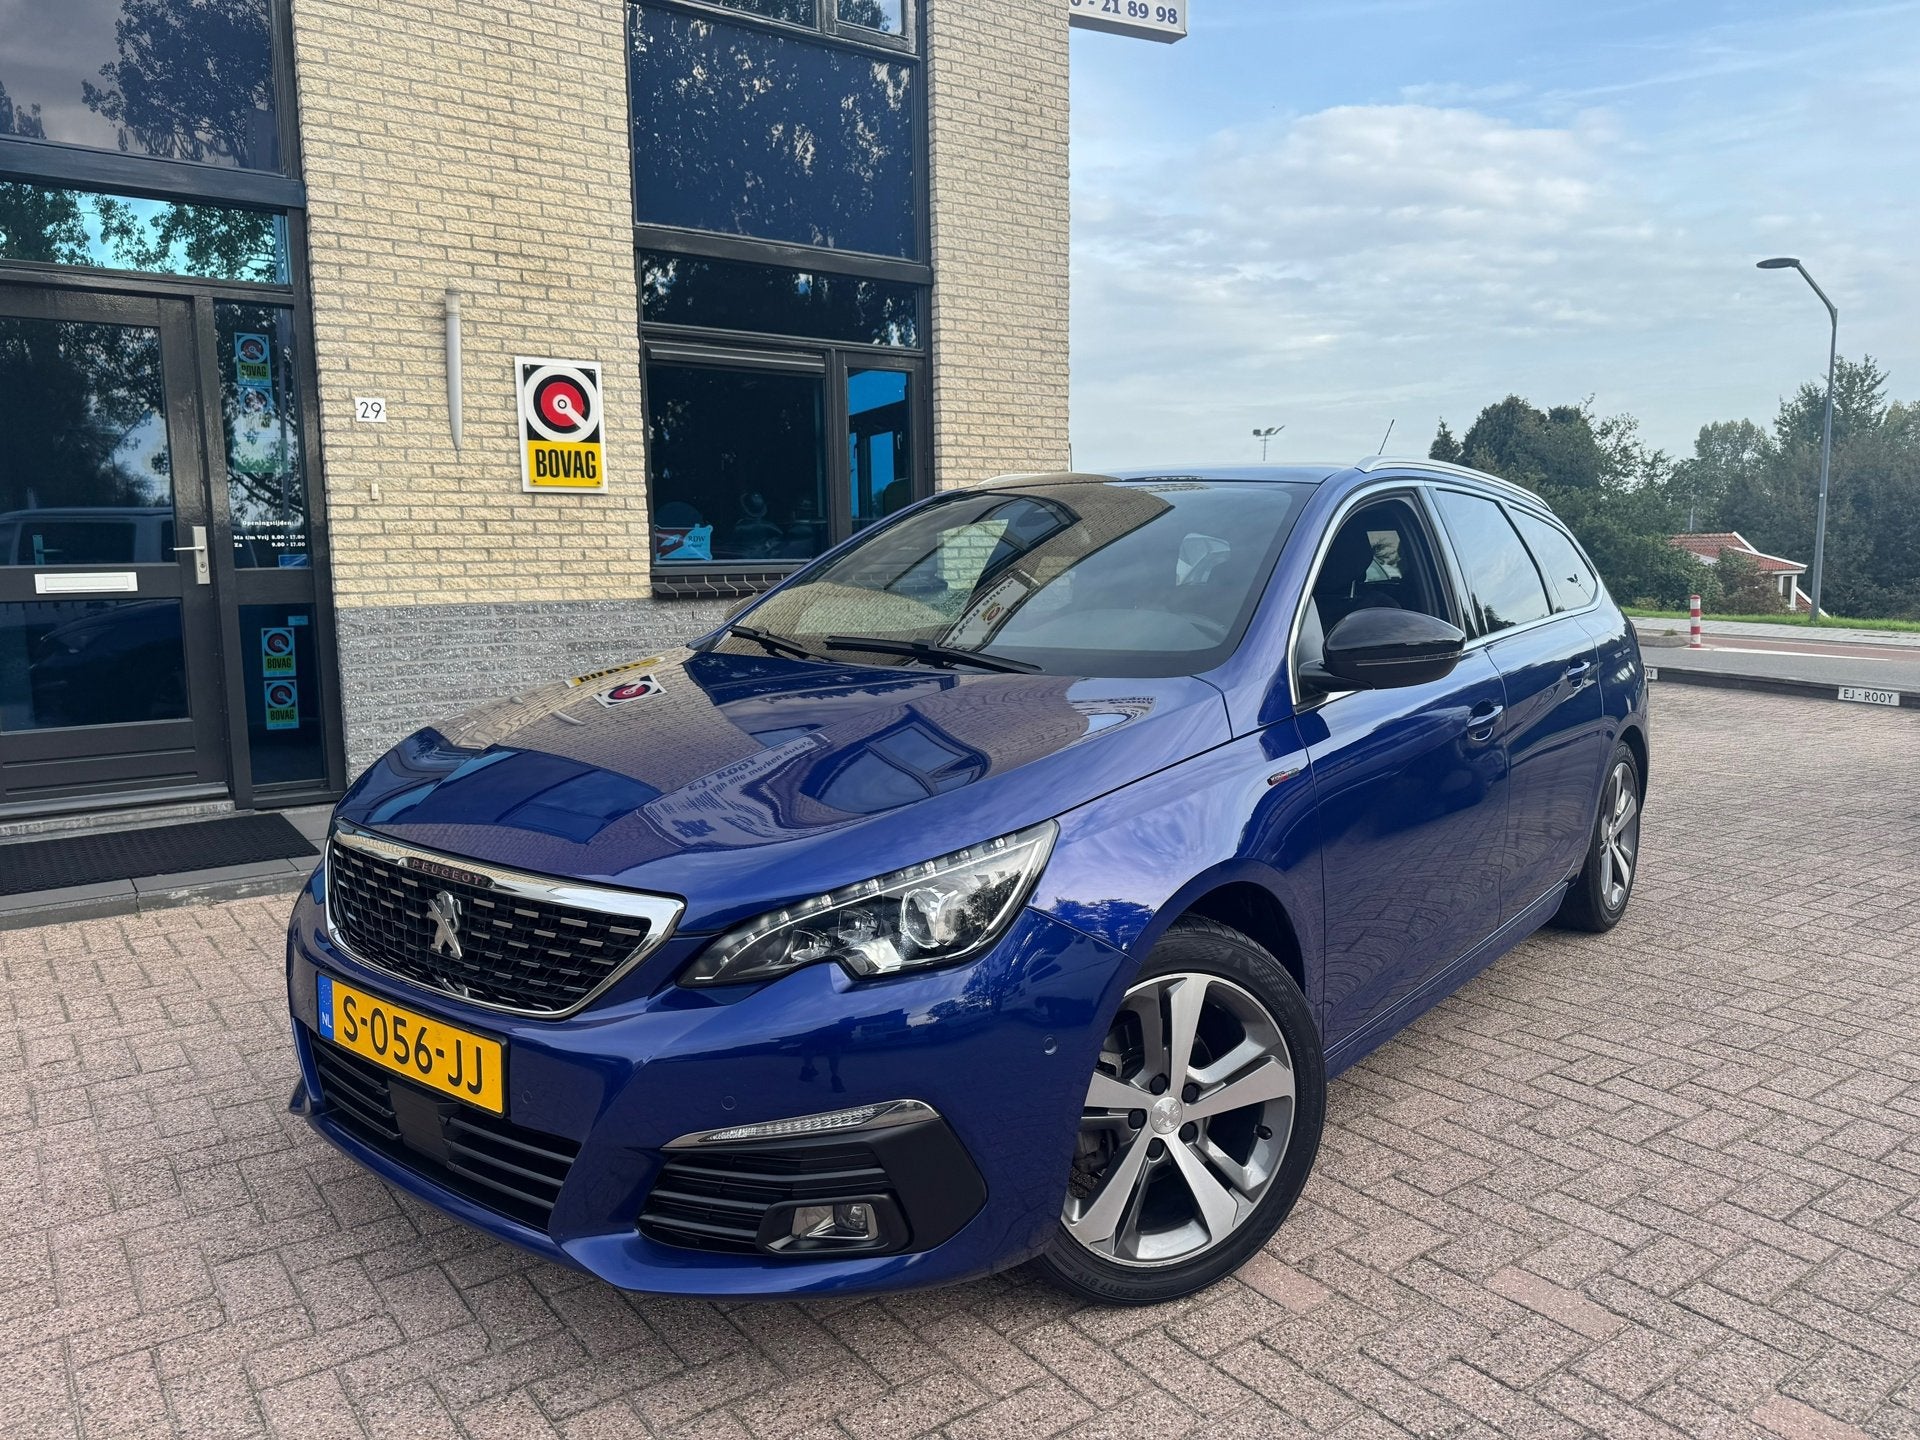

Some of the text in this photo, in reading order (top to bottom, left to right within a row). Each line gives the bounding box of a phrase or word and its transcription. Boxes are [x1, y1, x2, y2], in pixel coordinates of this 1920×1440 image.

[1101, 0, 1121, 14] 21
[1127, 1, 1149, 19] 89
[1155, 6, 1178, 24] 98
[359, 401, 382, 419] 29
[535, 449, 597, 479] BOVAG
[688, 535, 705, 543] RDW
[267, 657, 292, 669] BOVAG
[1843, 688, 1855, 699] EJ
[1864, 691, 1893, 703] ROOY
[270, 709, 295, 721] BOVAG
[715, 759, 757, 780] ROOY
[728, 773, 746, 786] alle
[748, 754, 783, 776] merken
[411, 858, 483, 885] PEUGEOT
[321, 1012, 332, 1029] NL
[343, 994, 484, 1096] S-056-JJ
